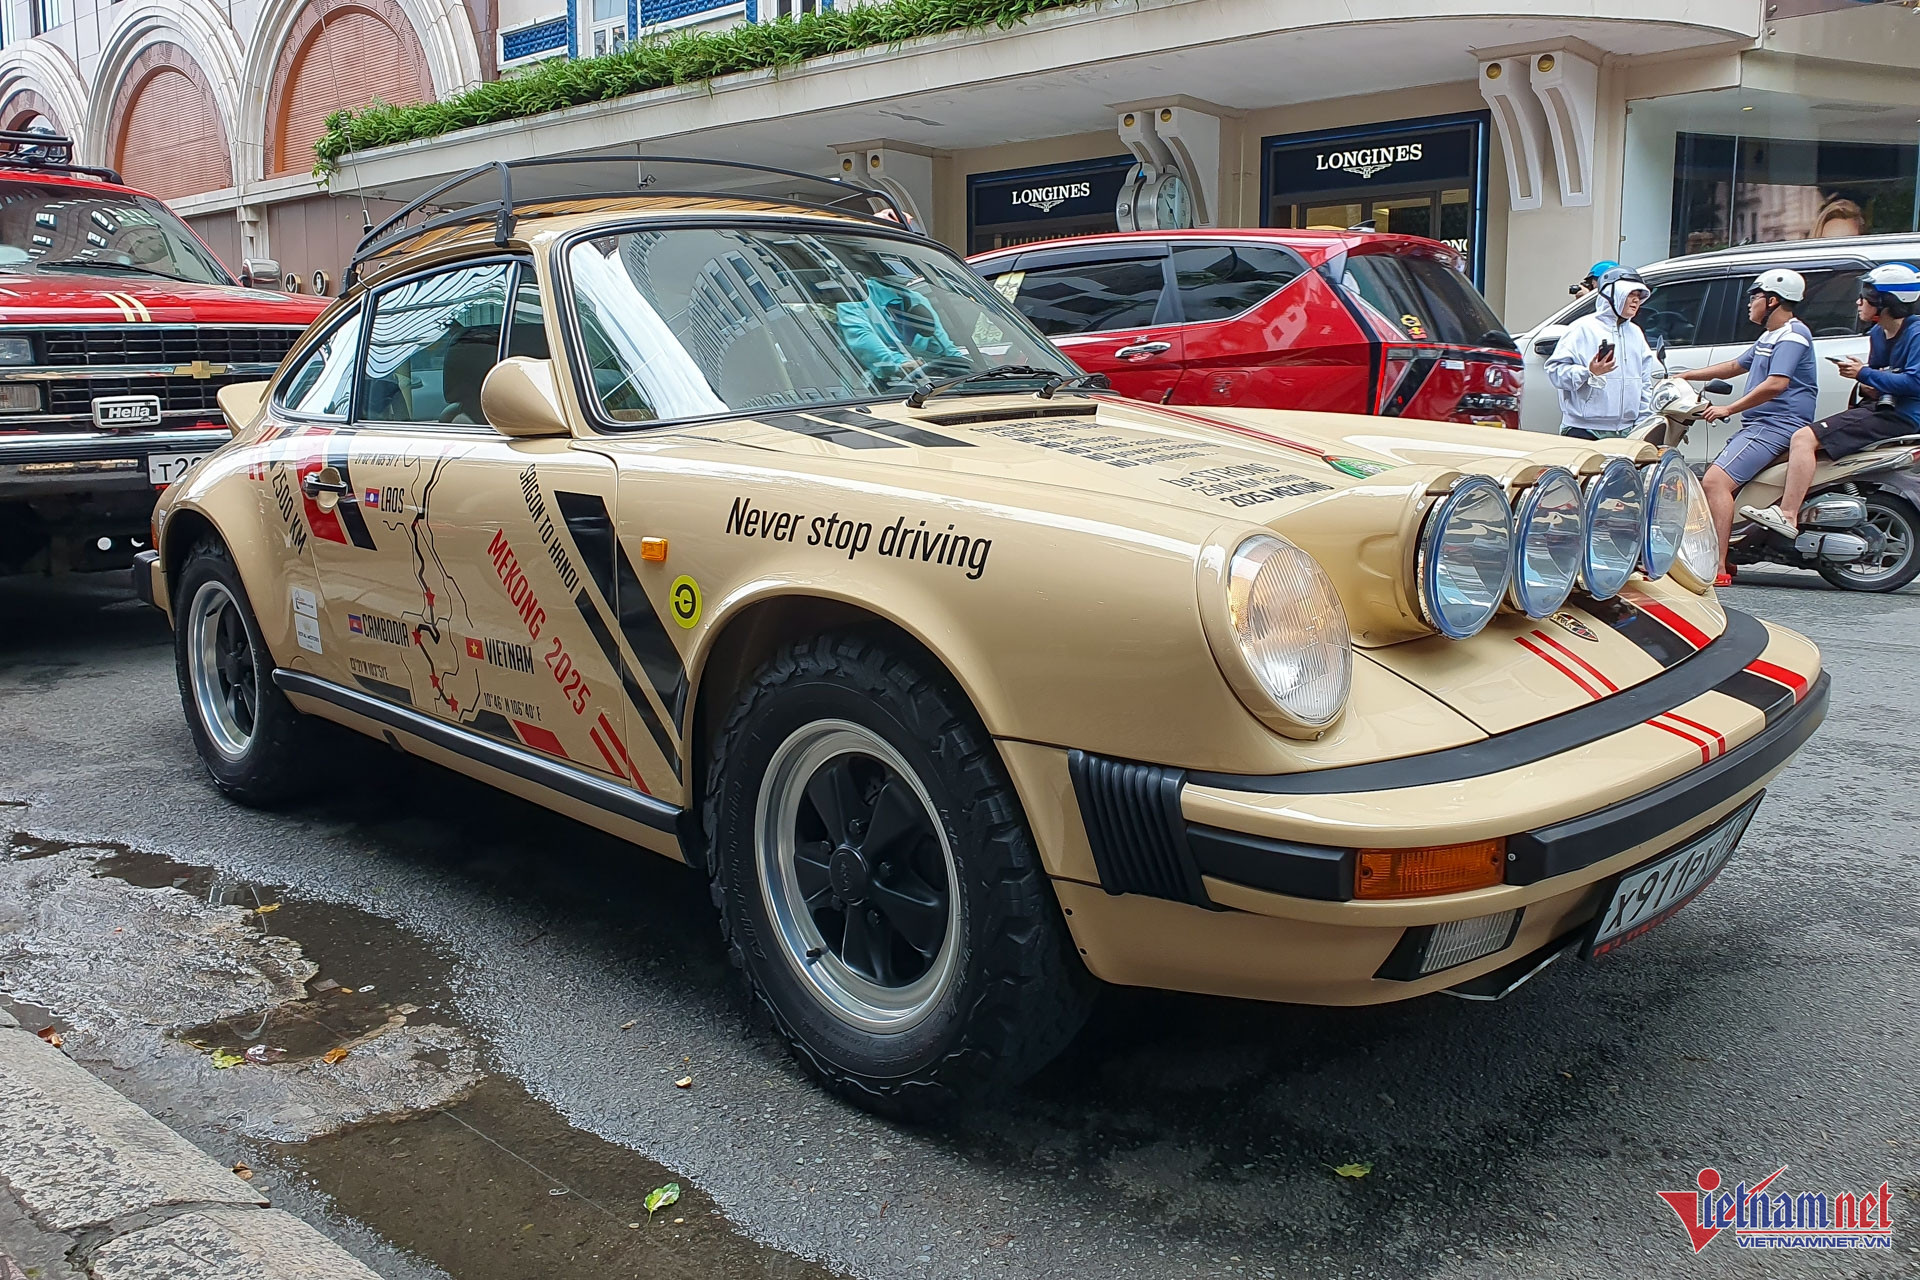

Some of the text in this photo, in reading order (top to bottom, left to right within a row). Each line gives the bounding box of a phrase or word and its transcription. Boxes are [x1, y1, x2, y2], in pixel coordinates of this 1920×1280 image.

[1315, 143, 1423, 171] LONGINES
[1011, 182, 1091, 205] LONGINES
[108, 406, 150, 419] Hella
[1104, 459, 1140, 469] NO
[1158, 463, 1281, 488] be STRONG
[380, 485, 405, 514] LAOS
[1191, 483, 1242, 497] 2500
[1230, 477, 1269, 489] KM
[1219, 481, 1336, 508] 2025 MEKONG
[271, 463, 308, 556] 2500 KM
[519, 463, 580, 595] SAIGON TO HANOI
[725, 496, 993, 581] Never stop driving
[361, 613, 411, 648] CAMBODIA
[486, 527, 593, 716] MEKONG 2025
[483, 636, 535, 676] VIETNAM
